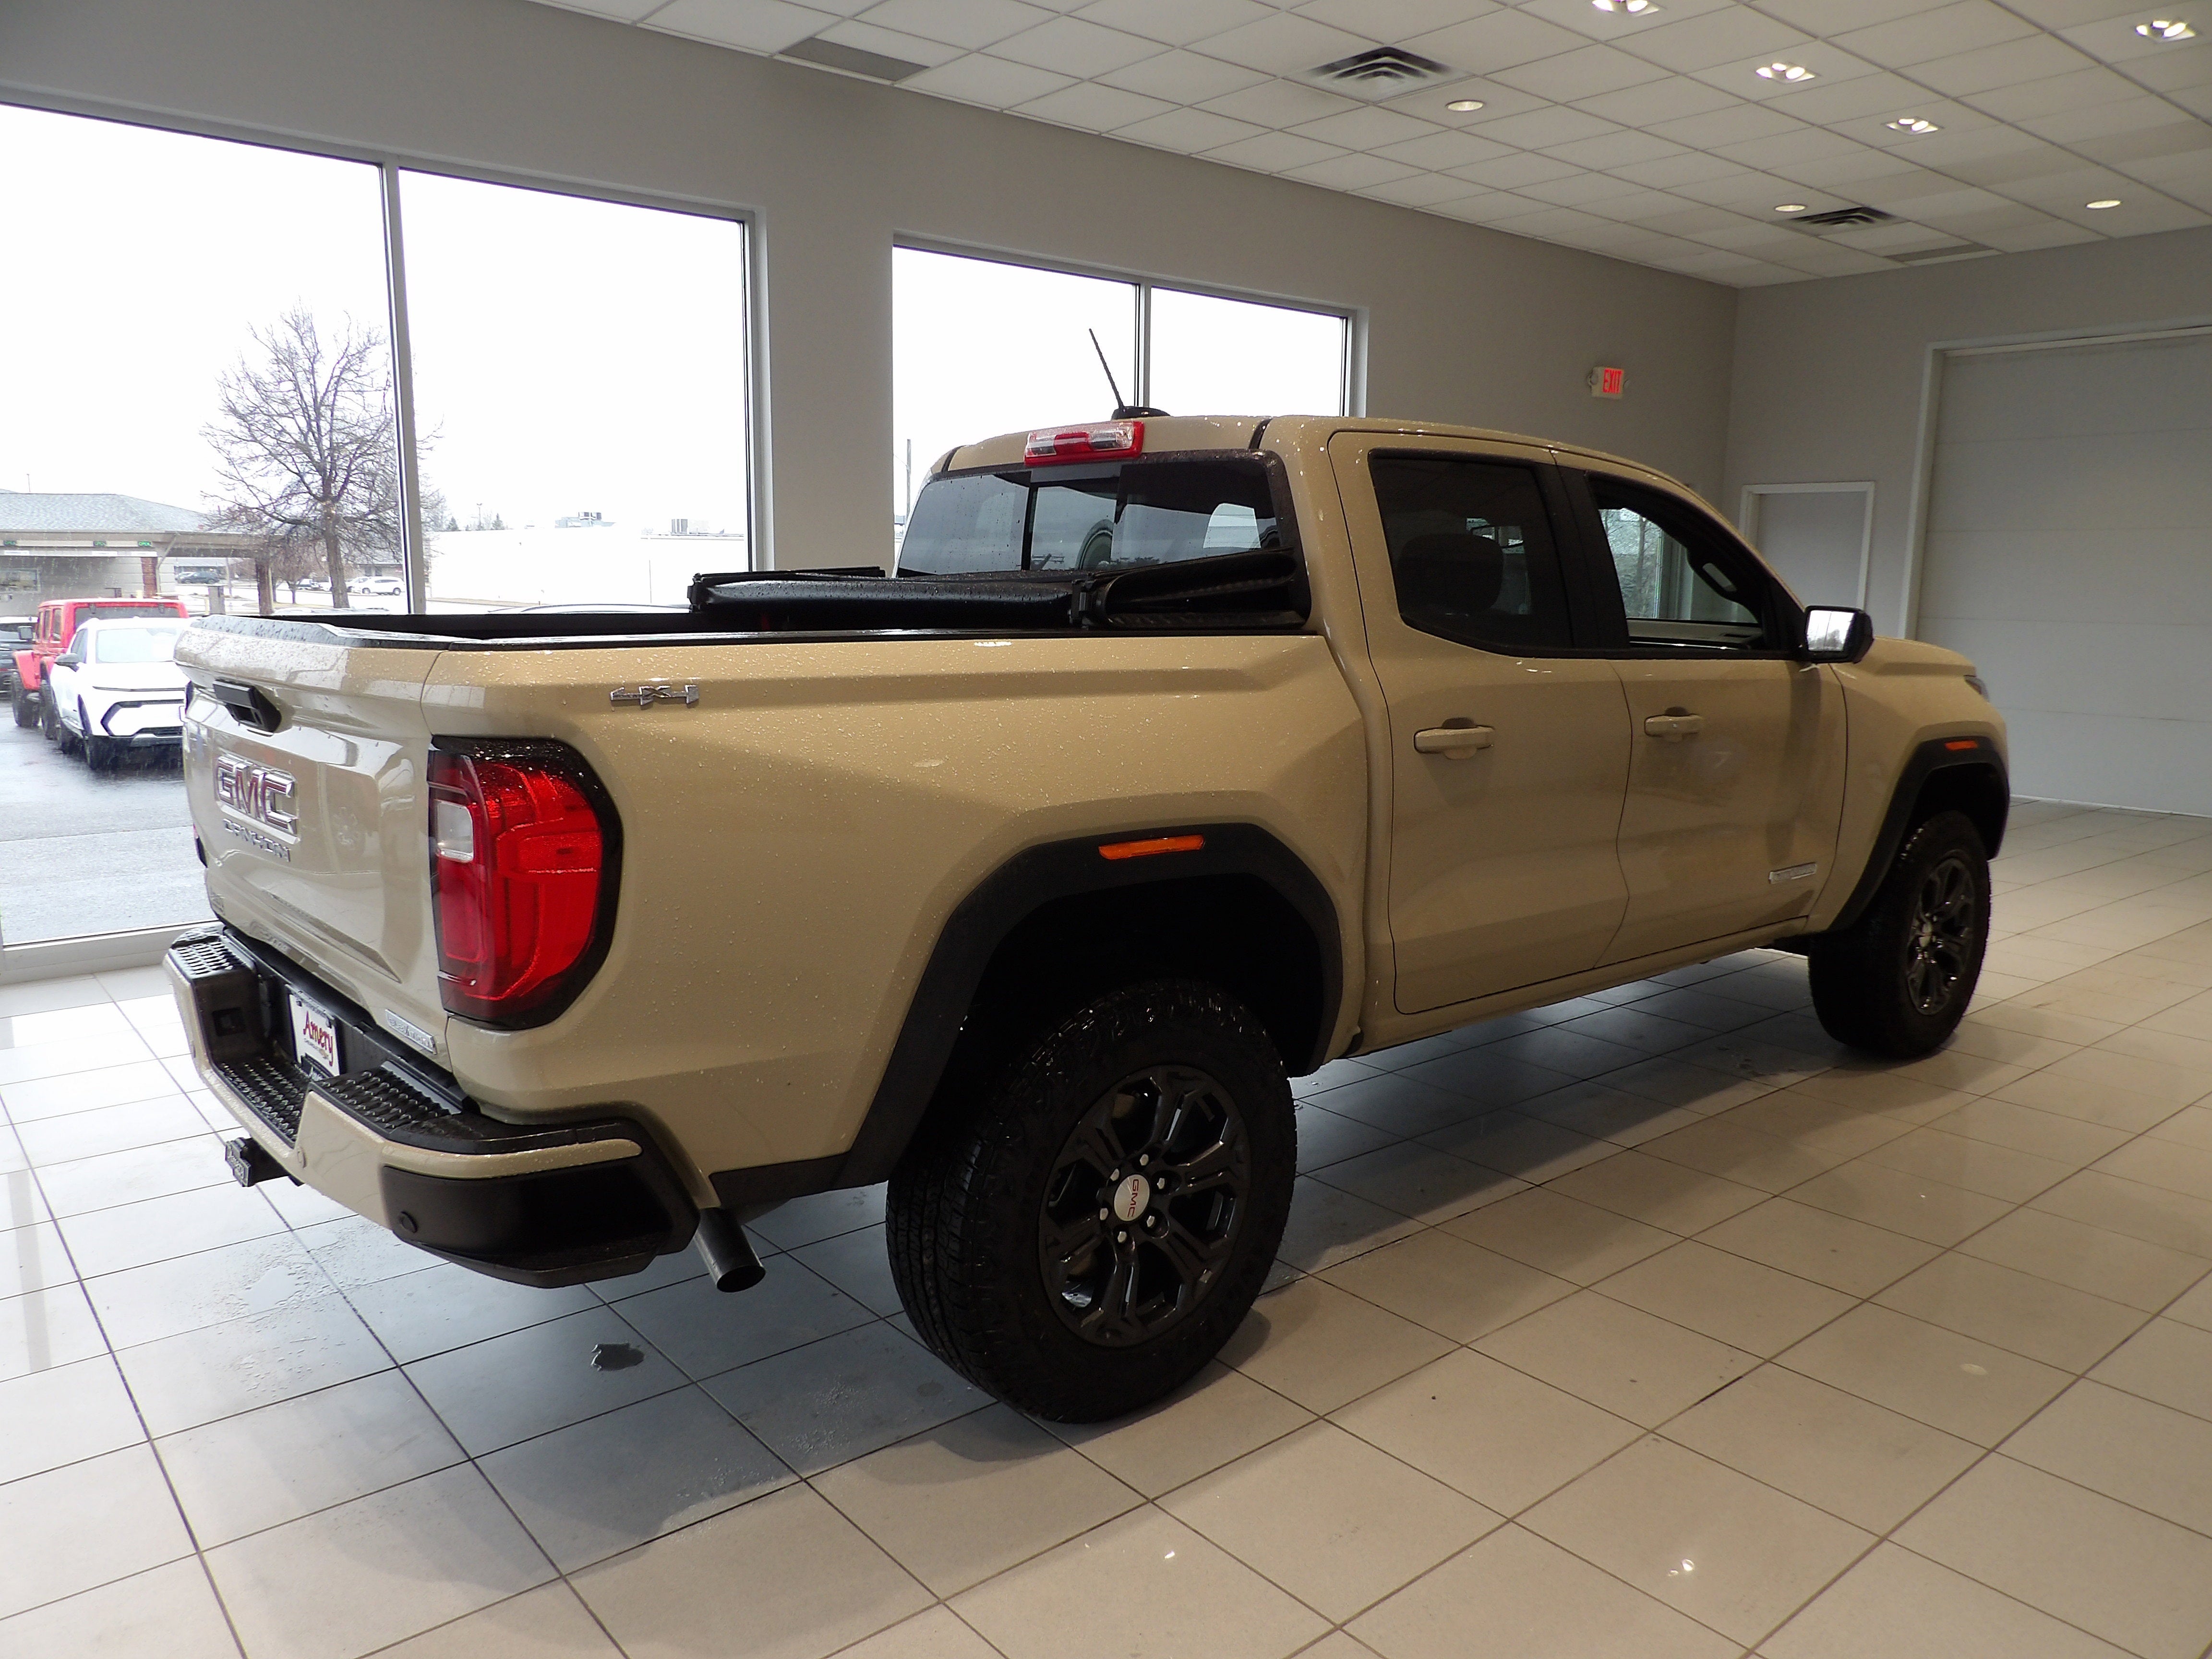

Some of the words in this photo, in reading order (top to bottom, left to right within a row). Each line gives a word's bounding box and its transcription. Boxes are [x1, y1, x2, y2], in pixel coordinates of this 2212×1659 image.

[1602, 368, 1622, 393] EXIT
[217, 754, 298, 836] GMC
[303, 1010, 333, 1067] Amery
[1127, 1179, 1139, 1218] GMC
